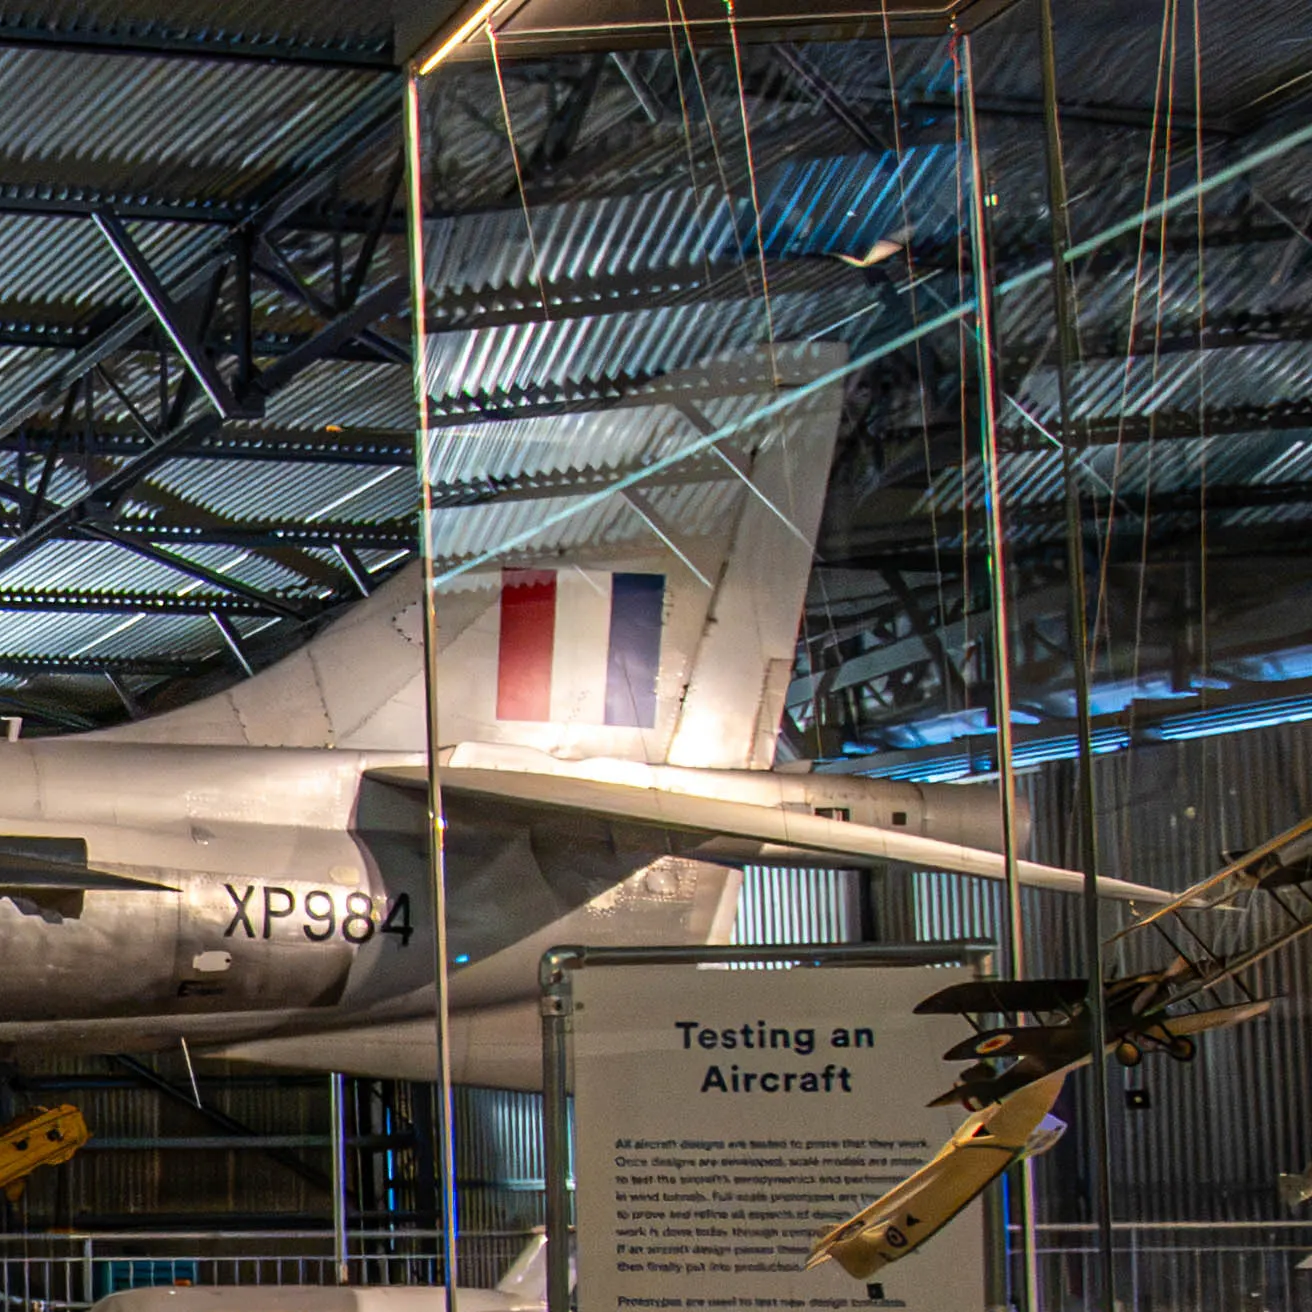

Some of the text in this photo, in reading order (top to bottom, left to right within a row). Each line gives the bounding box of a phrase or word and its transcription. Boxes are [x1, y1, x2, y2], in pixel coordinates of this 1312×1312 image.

[223, 882, 415, 947] XP984
[675, 1021, 875, 1055] Testing an
[700, 1064, 853, 1094] Aircraft
